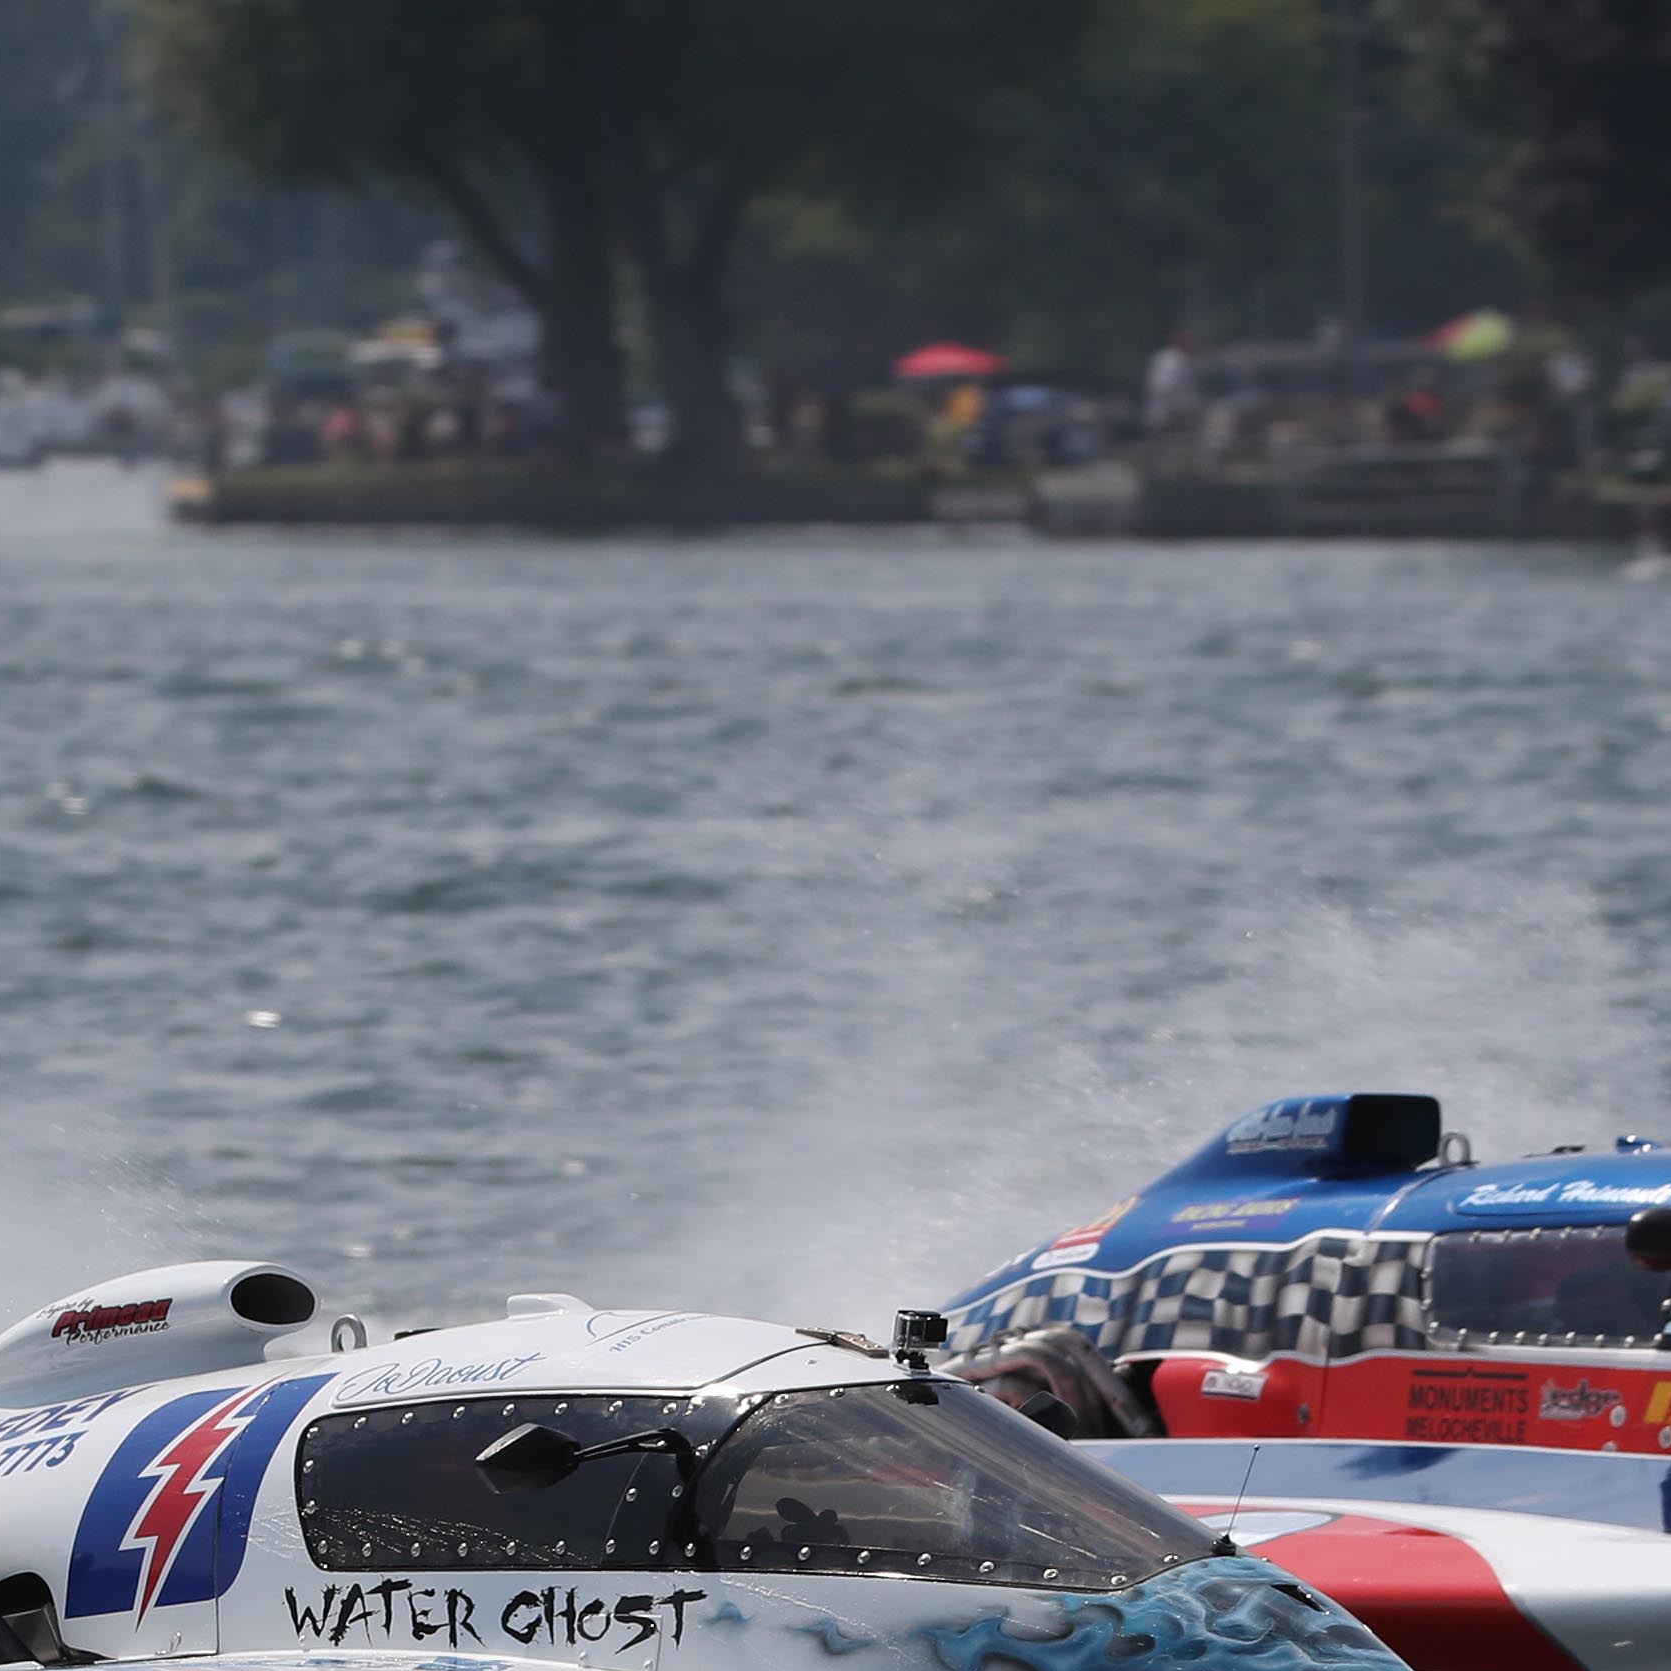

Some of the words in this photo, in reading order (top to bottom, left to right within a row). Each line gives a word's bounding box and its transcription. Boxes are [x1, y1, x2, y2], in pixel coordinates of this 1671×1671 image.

[64, 1322, 171, 1345] Performance
[1408, 1385, 1528, 1413] MONUMENTS
[283, 1577, 487, 1648] WATER
[501, 1584, 709, 1653] GHOST
